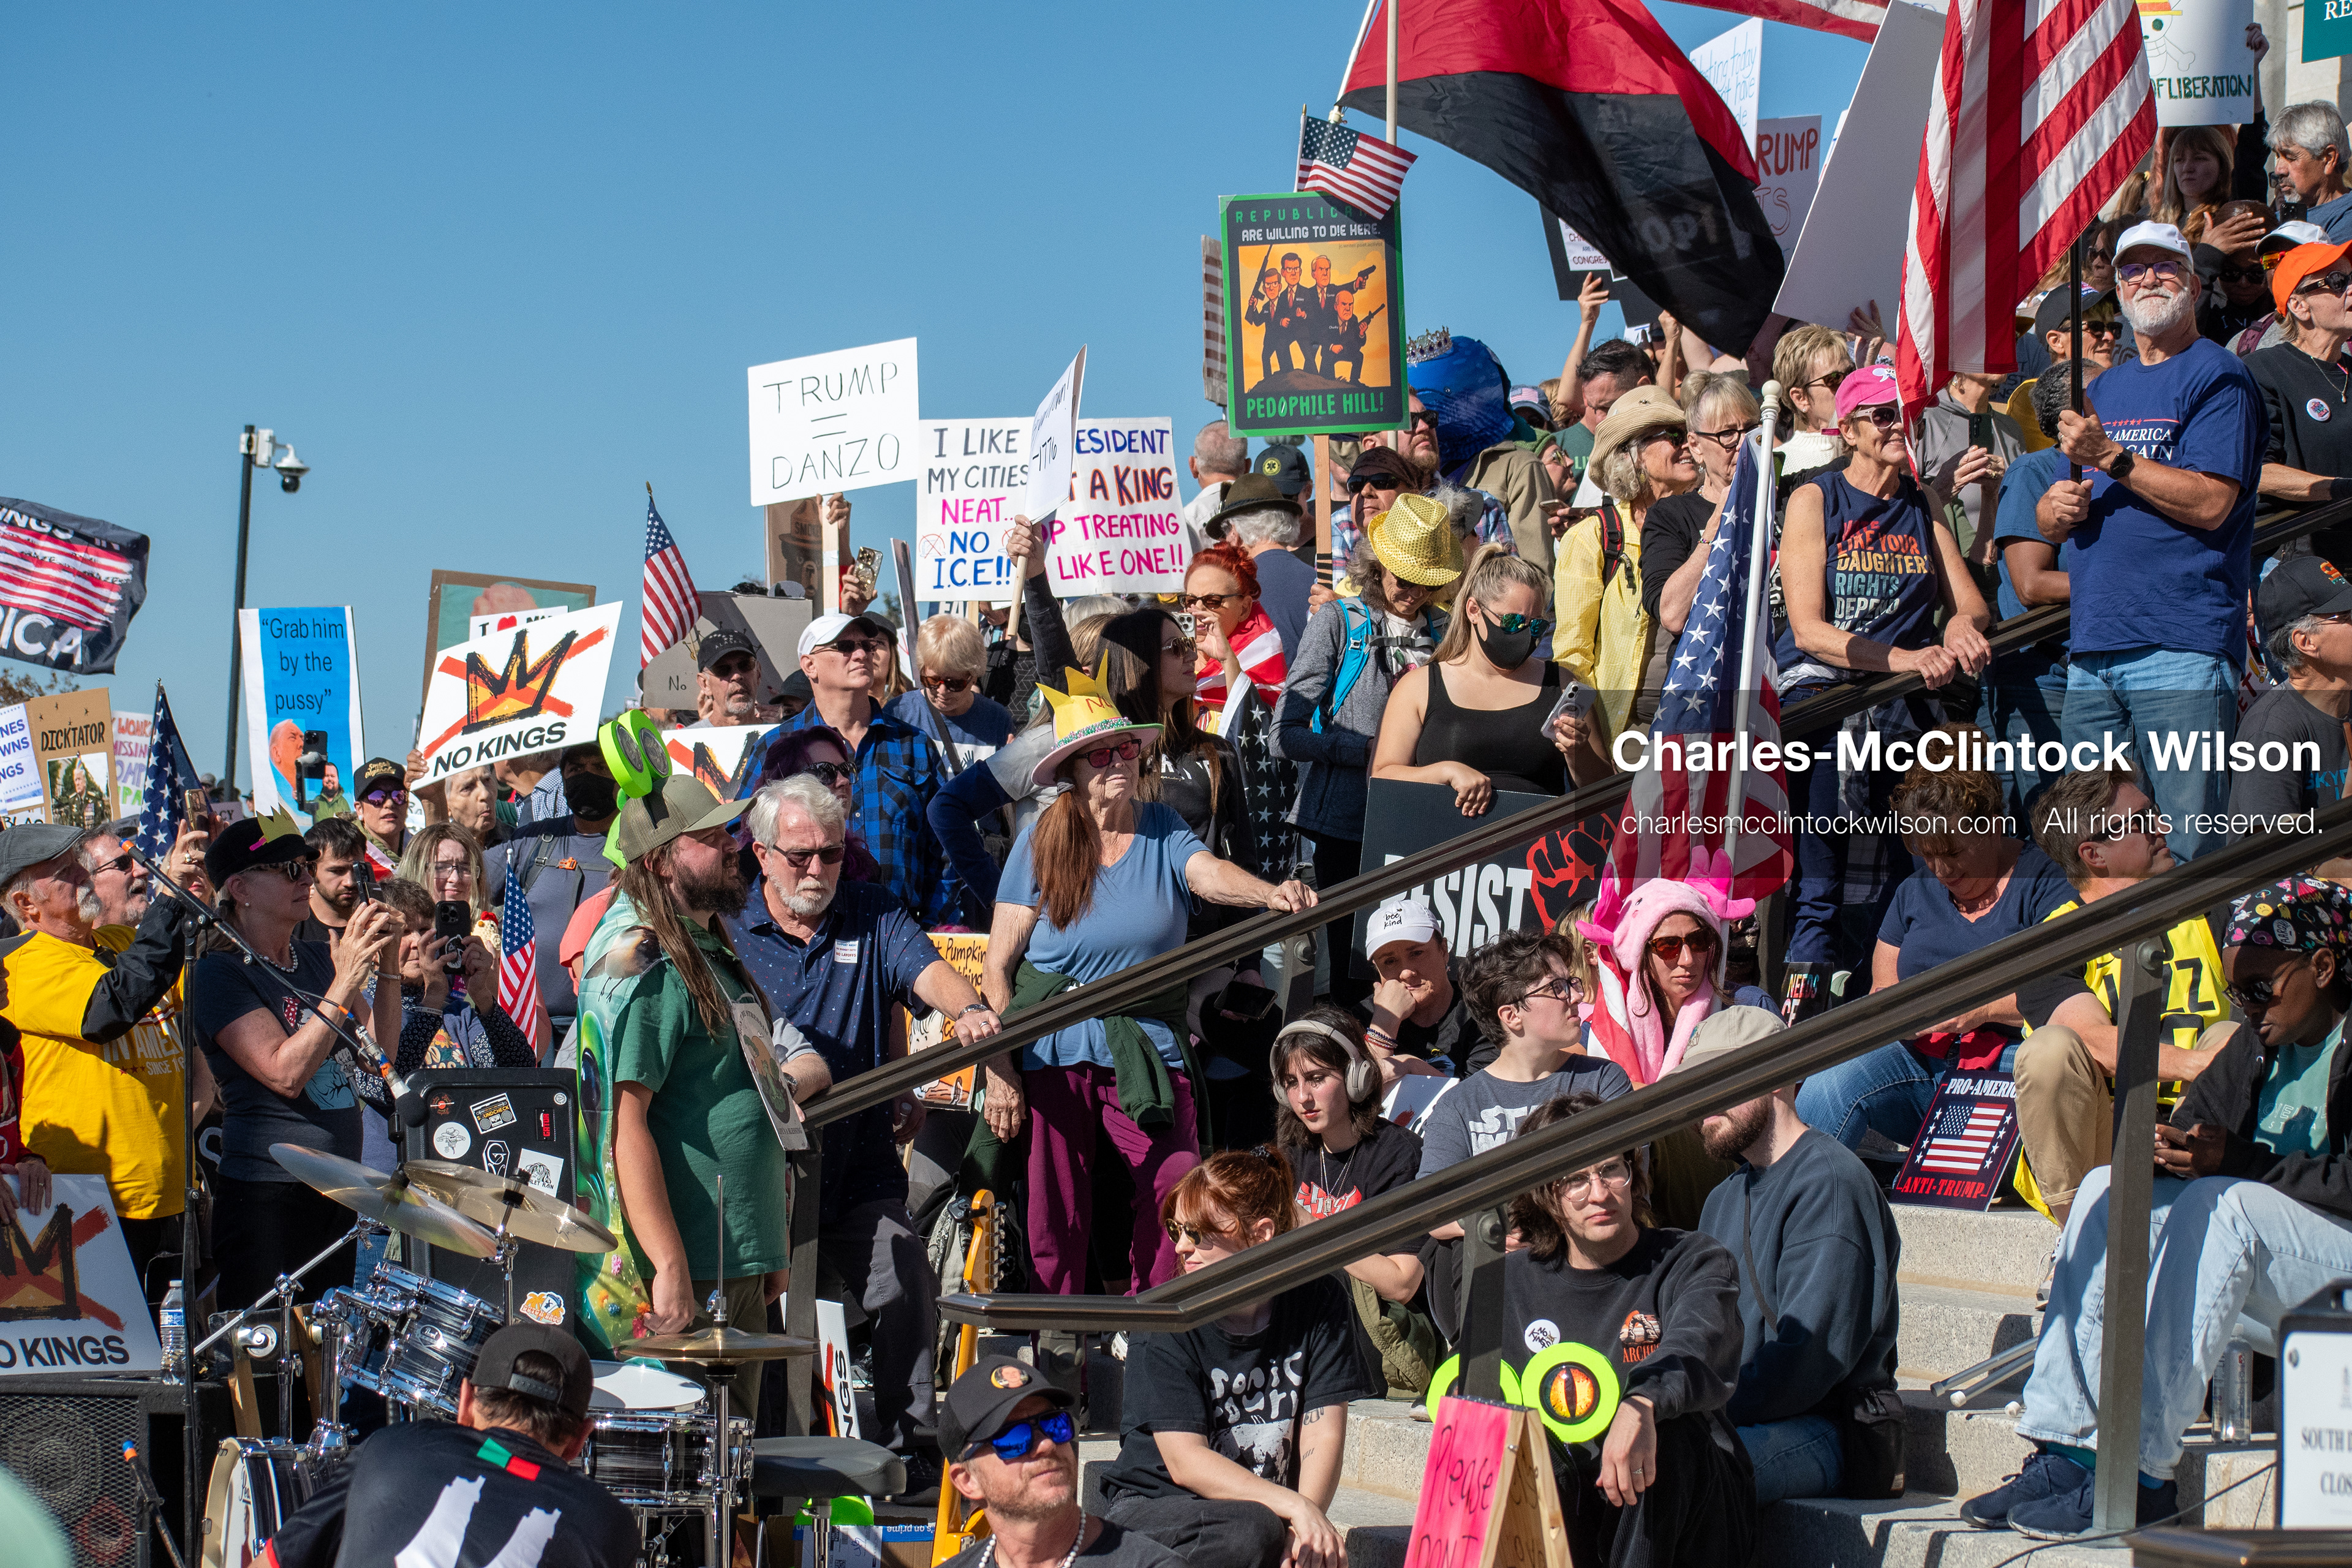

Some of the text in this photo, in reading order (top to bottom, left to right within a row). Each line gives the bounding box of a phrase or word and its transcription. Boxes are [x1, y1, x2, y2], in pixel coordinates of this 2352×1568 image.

[1730, 32, 1757, 79] today
[1734, 75, 1755, 106] have
[2167, 74, 2253, 100] LIBERATION
[1242, 228, 1263, 241] ARE
[1266, 226, 1309, 240] WILLING
[1313, 225, 1327, 238] TO
[763, 362, 897, 414] TRUMP
[1343, 391, 1384, 413] HILL!
[933, 428, 1020, 458] I LIKE
[2111, 428, 2173, 443] AMERICA
[772, 433, 899, 489] DANZO
[927, 464, 1029, 494] MY CITIES
[1090, 469, 1110, 501] A
[1113, 464, 1174, 507] KING
[1074, 512, 1180, 541] TREATING
[949, 530, 989, 555] NO
[1836, 530, 1921, 556] LIKE YOUR
[1057, 550, 1115, 580] LIKE
[1120, 544, 1185, 575] ONE!!
[1835, 572, 1899, 597] RIGHTS
[312, 617, 344, 639] him
[715, 639, 744, 649] ALASKA
[279, 650, 333, 676] by the
[669, 675, 687, 692] No
[40, 722, 105, 752] DICKTATOR
[433, 722, 568, 777] NO KINGS
[1383, 918, 1403, 930] kind
[1385, 912, 1401, 921] bee
[1787, 973, 1820, 999] NEEDS
[1902, 1176, 1986, 1199] ANTI-TRUMP
[19, 1335, 130, 1368] KINGS
[2301, 1426, 2345, 1453] SOUTH
[1425, 1419, 1493, 1523] Please
[886, 1525, 913, 1533] prime
